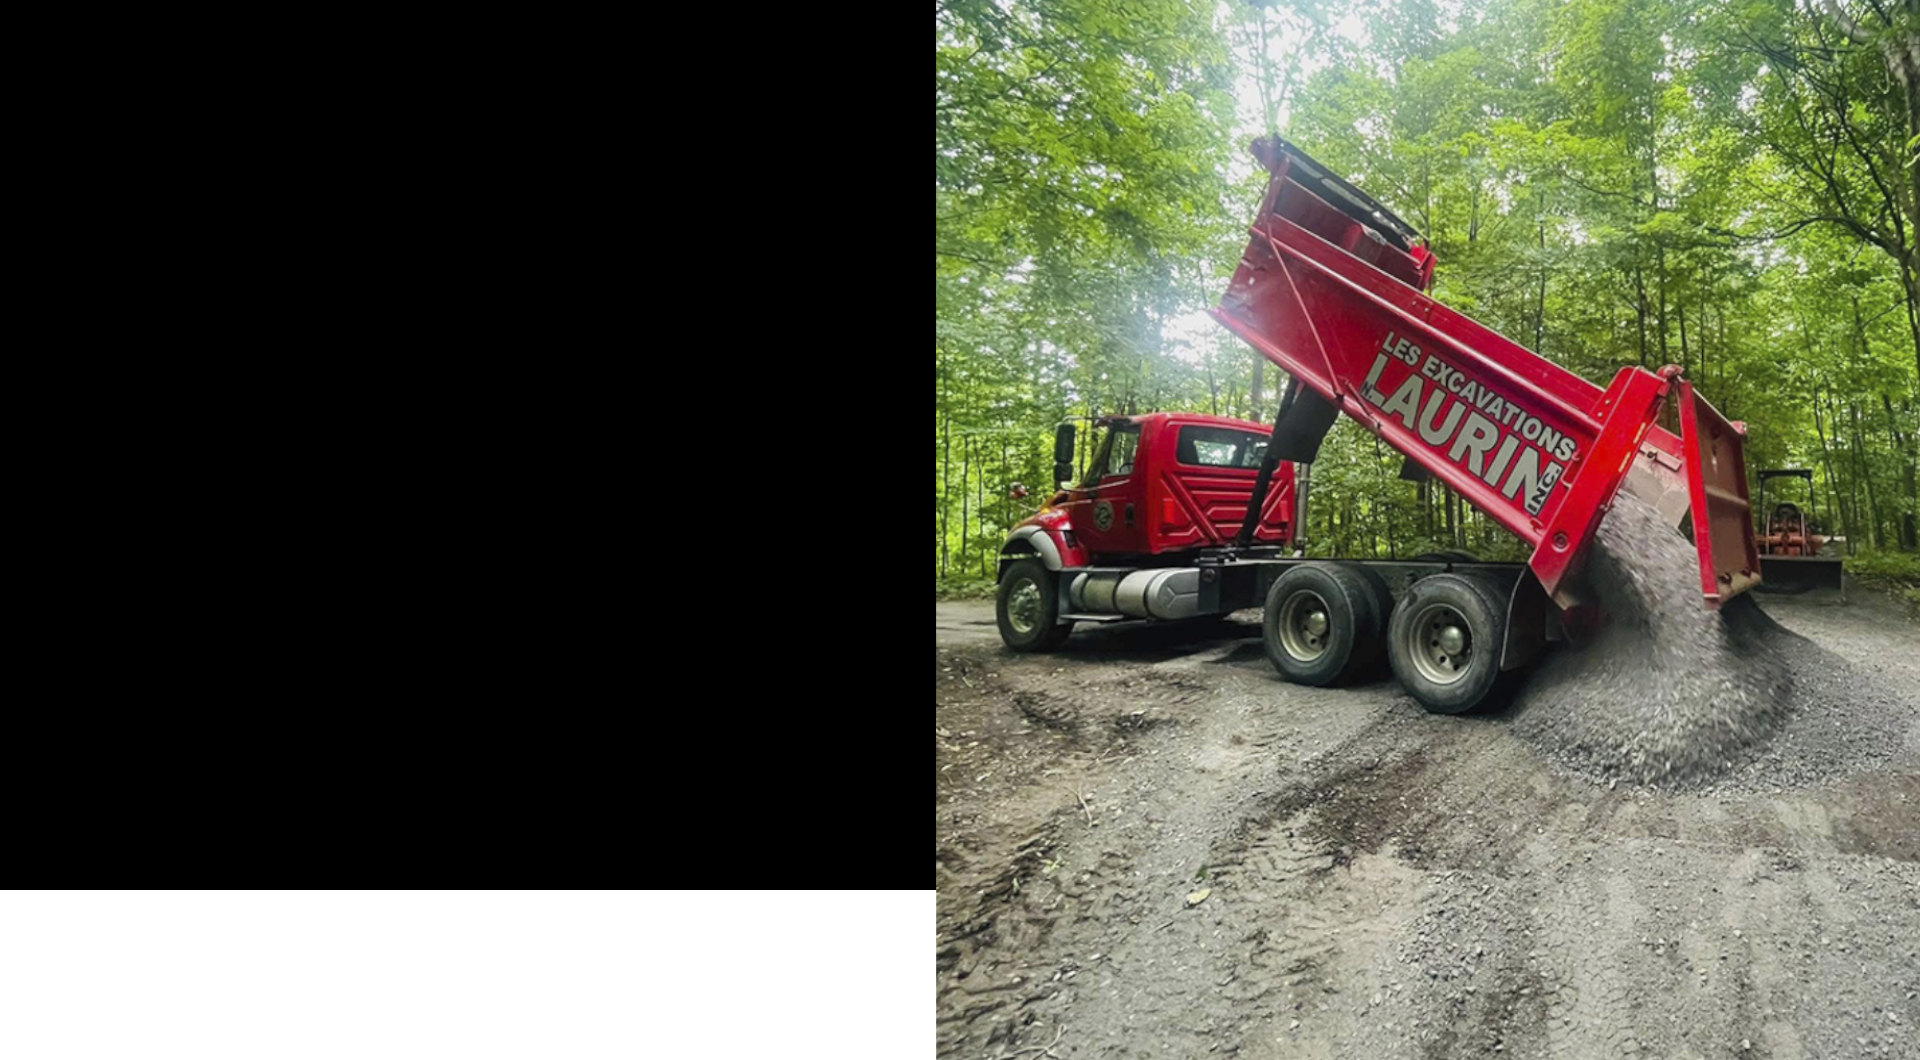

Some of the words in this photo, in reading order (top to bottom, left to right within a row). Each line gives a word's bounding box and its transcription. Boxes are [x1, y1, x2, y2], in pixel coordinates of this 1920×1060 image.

[1360, 352, 1563, 516] LAURIN
[1382, 331, 1422, 366] LES
[1421, 355, 1577, 462] EXCAVATIONS
[1527, 467, 1561, 512] INC.
